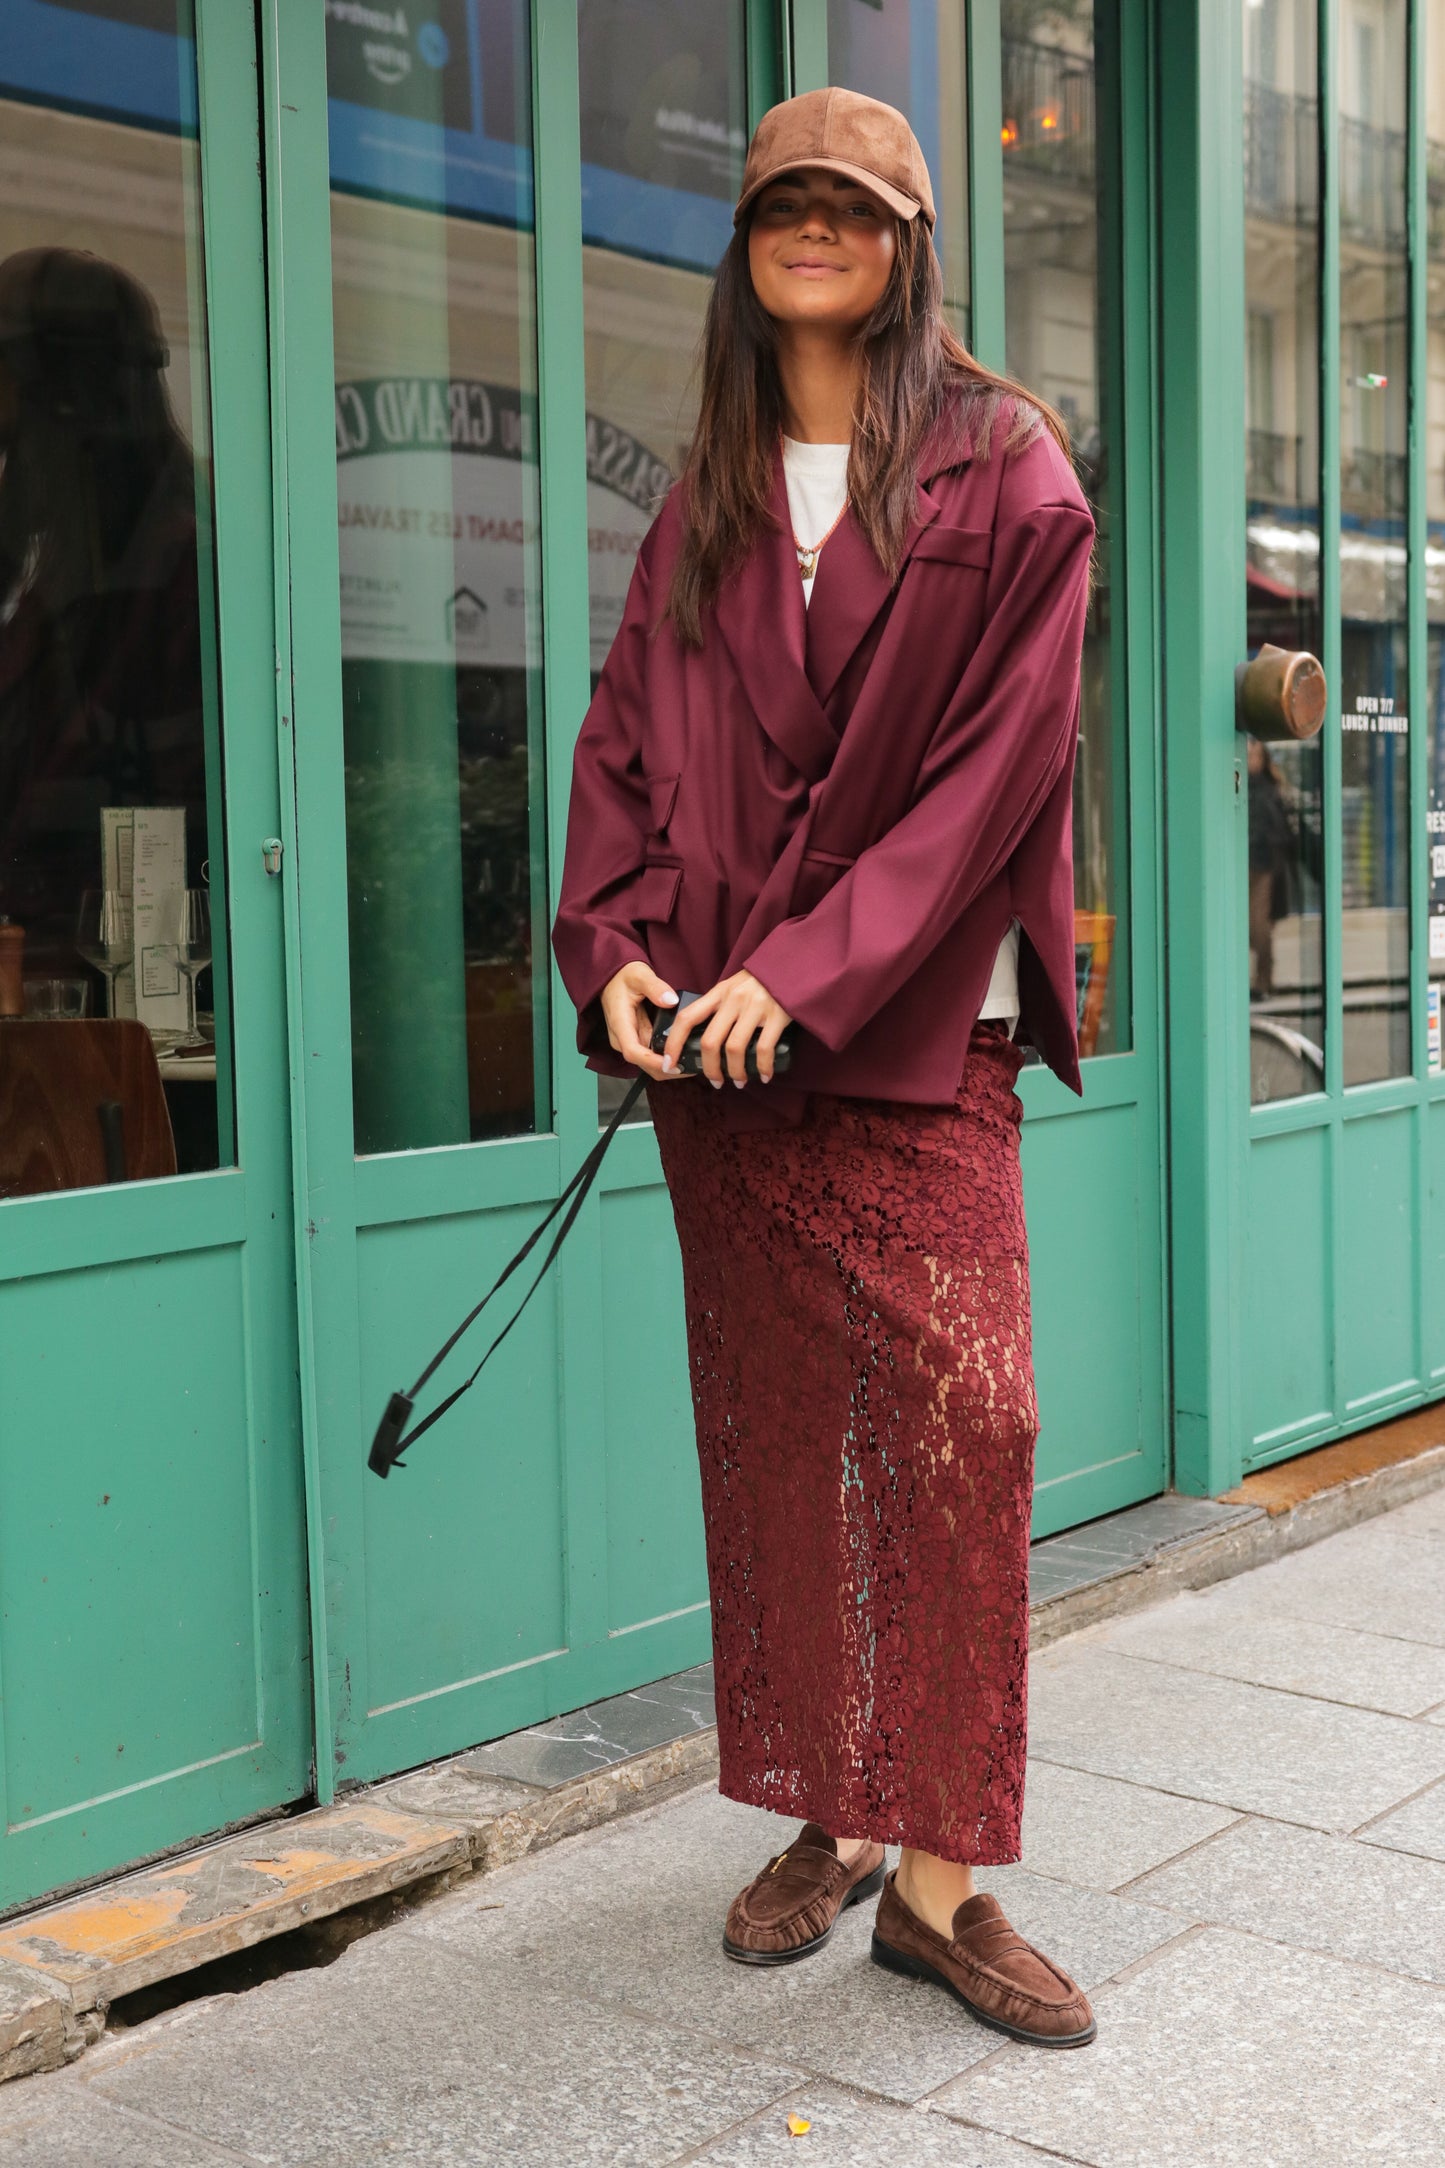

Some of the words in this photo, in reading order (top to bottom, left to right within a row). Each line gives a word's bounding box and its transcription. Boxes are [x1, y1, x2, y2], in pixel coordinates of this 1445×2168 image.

[1356, 696, 1379, 713] OPEN
[1380, 697, 1394, 714] 7/7
[1342, 713, 1369, 731] LUNCH
[1370, 718, 1377, 732] &
[1378, 715, 1408, 733] DINNER
